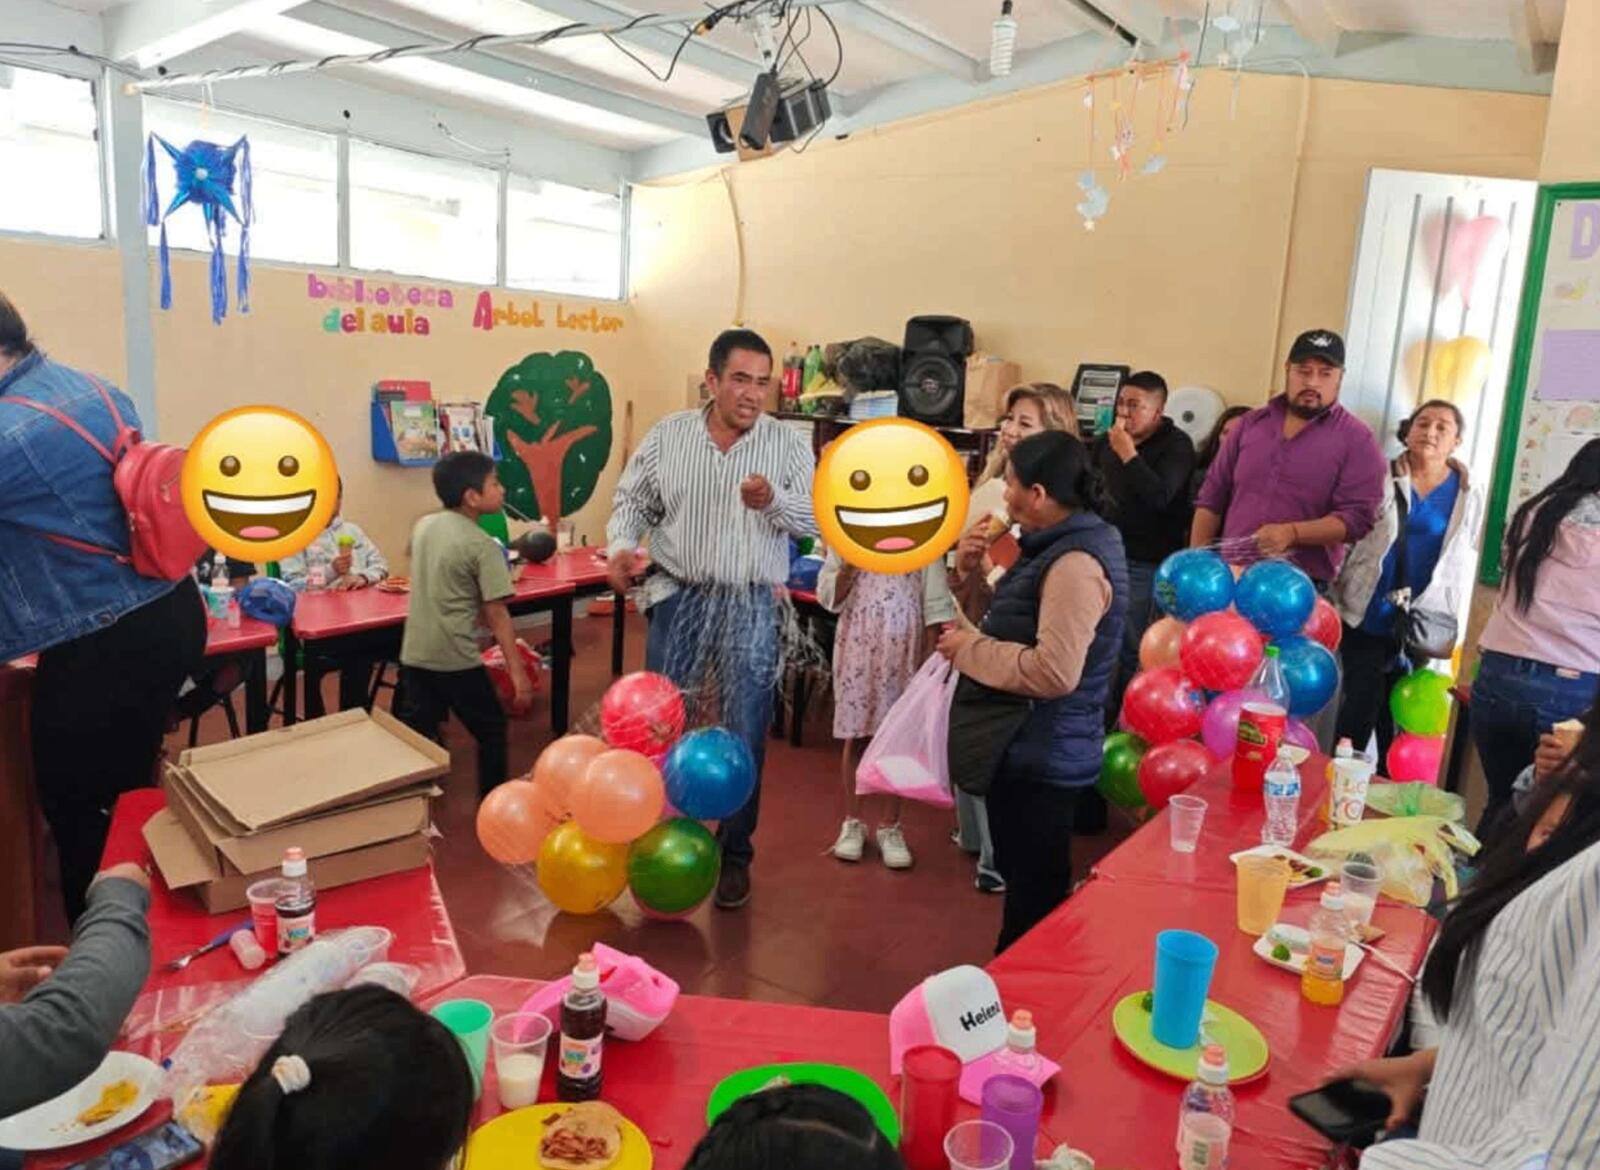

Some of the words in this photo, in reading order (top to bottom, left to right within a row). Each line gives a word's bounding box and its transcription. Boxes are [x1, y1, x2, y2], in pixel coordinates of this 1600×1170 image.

[322, 306, 365, 332] del
[370, 308, 430, 335] aula
[557, 303, 624, 333] Lector
